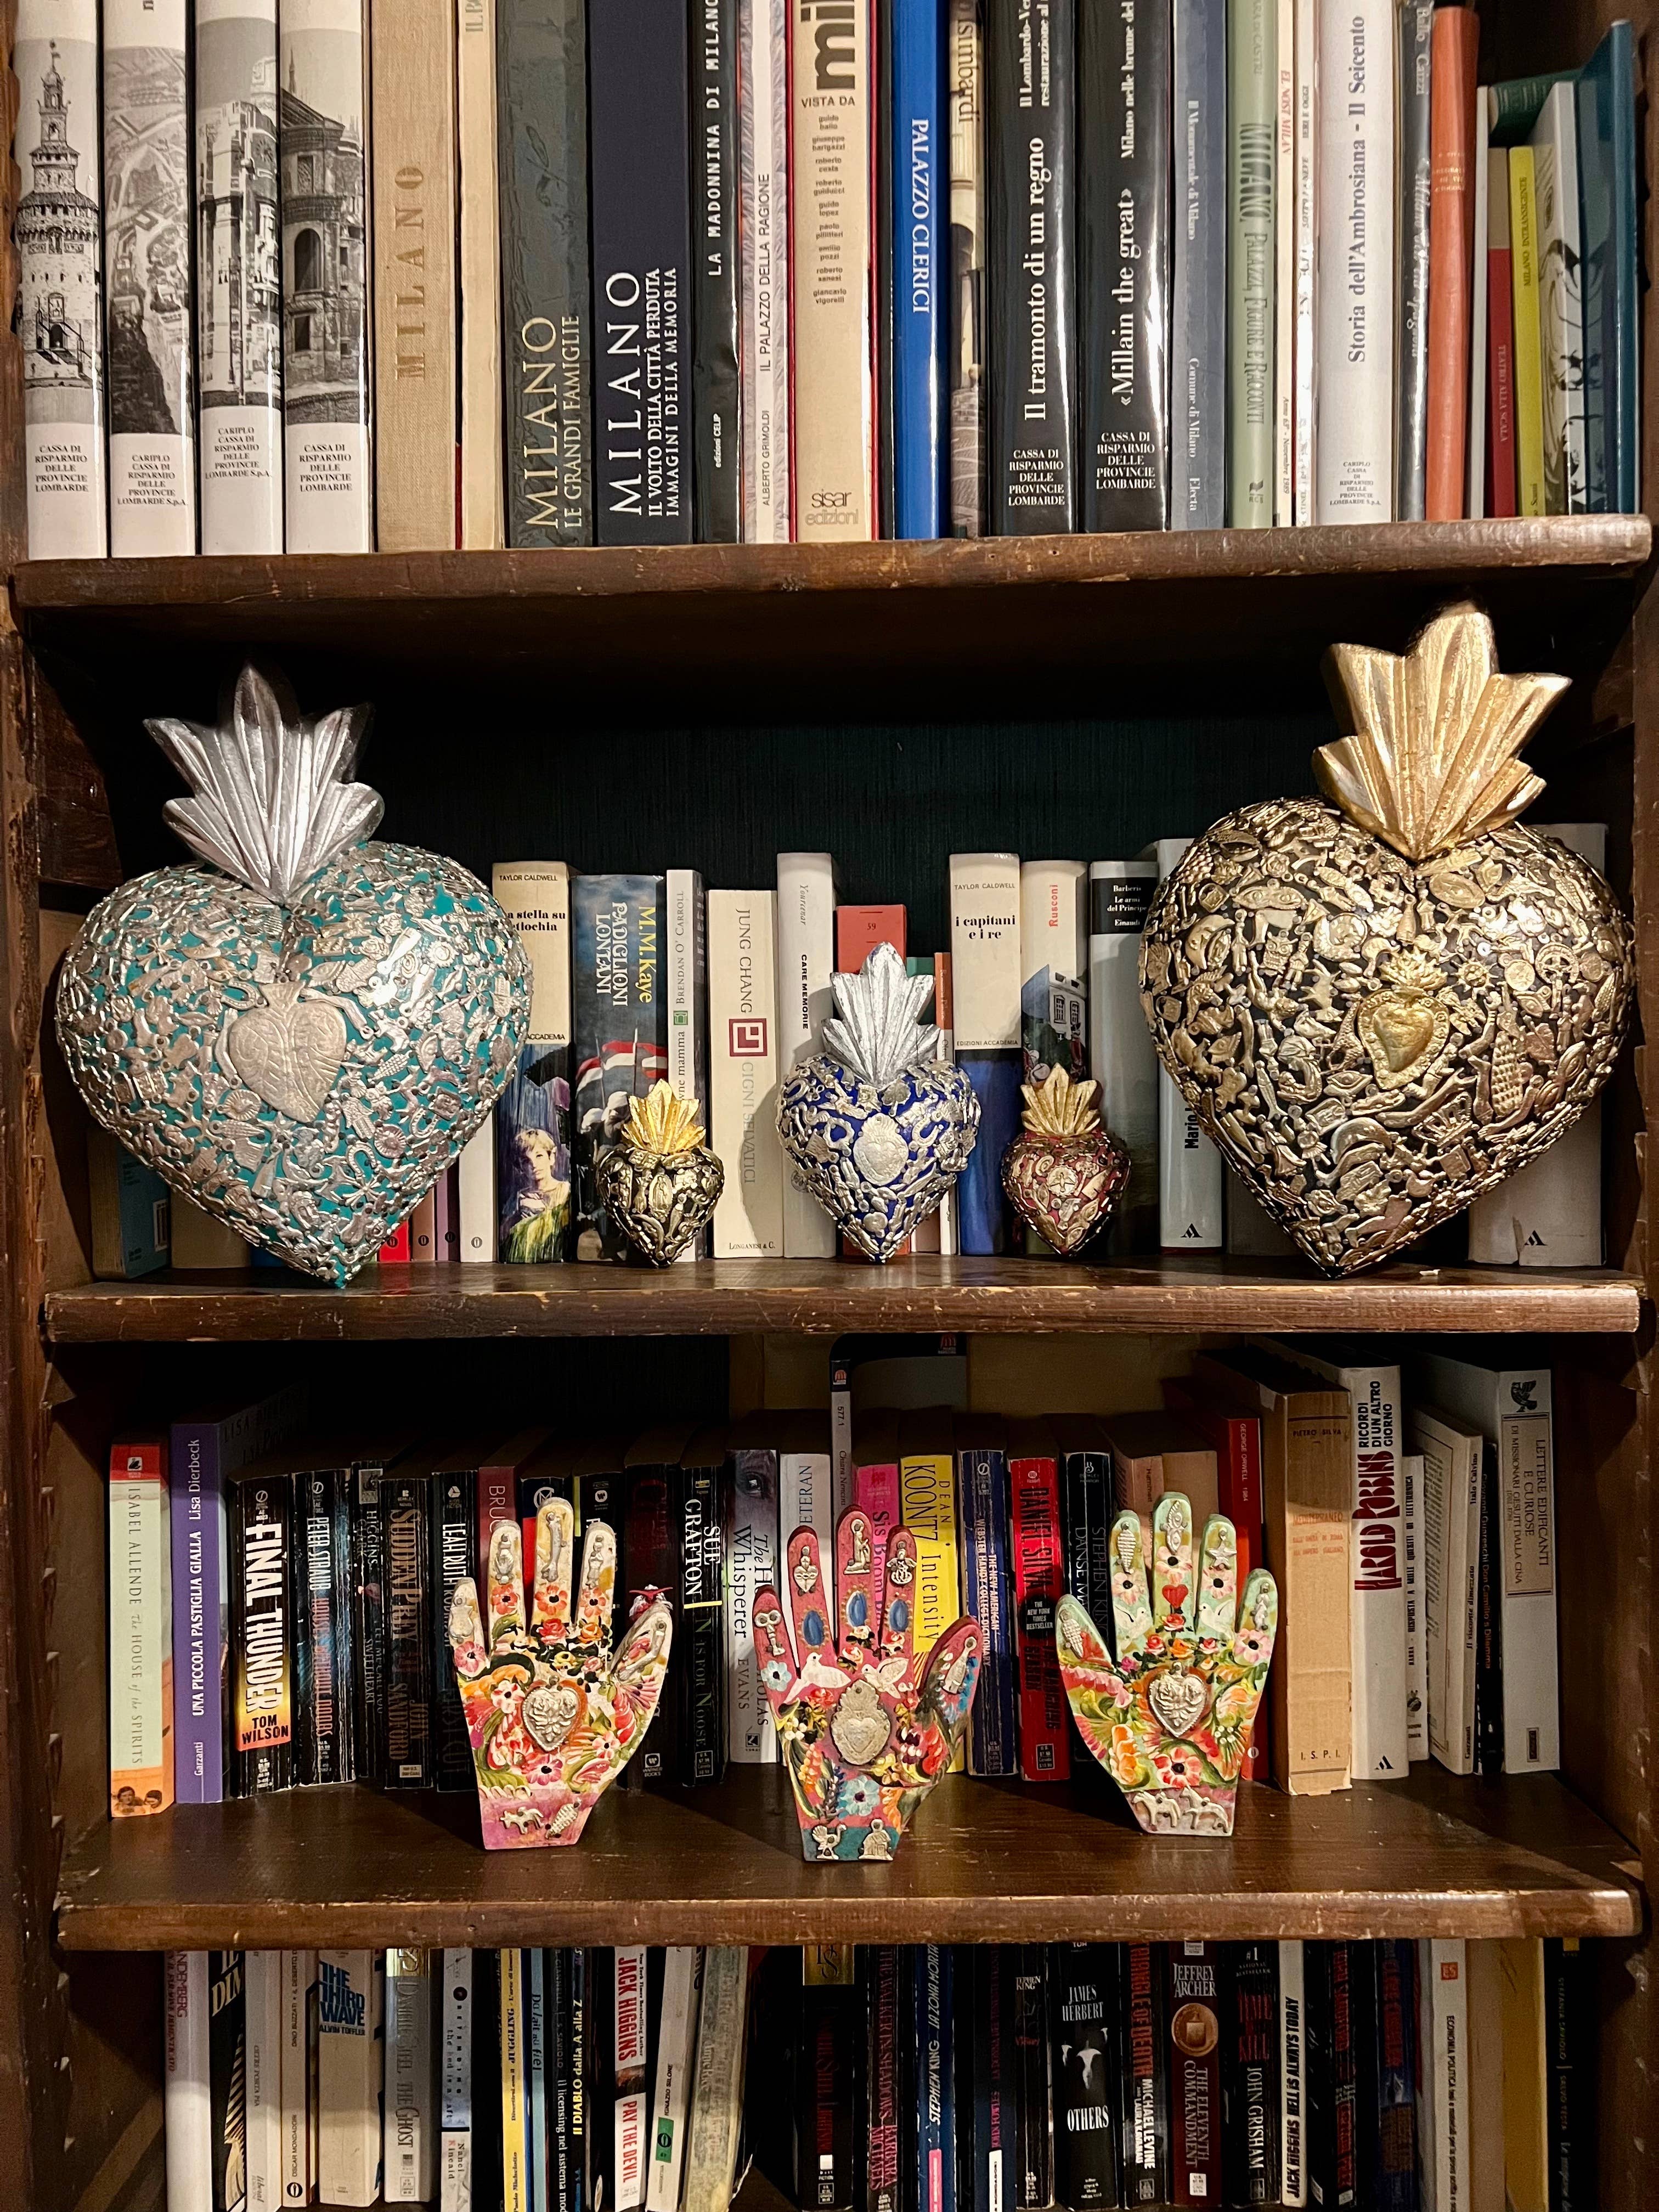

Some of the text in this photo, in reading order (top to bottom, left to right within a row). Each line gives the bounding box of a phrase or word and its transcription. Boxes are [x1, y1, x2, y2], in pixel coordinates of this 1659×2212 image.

[1348, 16, 1365, 93] Seicento
[706, 86, 720, 109] DI
[802, 96, 855, 108] VISTA DA
[1348, 104, 1365, 117] Il
[707, 125, 721, 237] MADONNINA
[912, 119, 929, 313] PALAZZO CLERICI
[395, 167, 425, 380] MILANO
[708, 252, 721, 275] LA
[1023, 137, 1052, 420] Il tramonto di un regno
[1111, 188, 1142, 406] «Millain the great»
[1348, 306, 1365, 362] Storia
[606, 272, 642, 516] MILANO
[644, 268, 662, 516] IL VOLTO DELLA CITTÀ PERDUTA
[664, 268, 679, 516] IMMAGINI DELLA MEMORIA
[522, 317, 558, 527] MILANO
[561, 315, 582, 527] LE GRANDI FAMIGLIE
[761, 410, 770, 458] GRIMOLDI
[1101, 431, 1150, 442] CASSA DI
[299, 454, 351, 462] RISPARMIO
[1009, 461, 1064, 471] RISPARMIO
[1014, 449, 1059, 459] CASSA DI
[1097, 443, 1155, 455] RISPARMIO
[1108, 455, 1144, 466] DELLE
[300, 474, 351, 482] PROVINCIE
[300, 483, 352, 492] LOMBARDE
[1009, 484, 1064, 494] PROVINCIE
[1019, 472, 1053, 482] DELLE
[1096, 479, 1156, 489] LOMBARDE
[1097, 467, 1155, 478] PROVINCIE
[805, 509, 858, 526] edizioni
[812, 489, 851, 508] sisar
[1008, 495, 1065, 506] LOMBARDE
[517, 910, 549, 918] stella
[956, 915, 1015, 928] i capitani
[1049, 884, 1058, 927] Rusconi
[596, 913, 611, 994] LONTANI
[612, 901, 629, 1007] PADIGLIONI
[969, 929, 1001, 940] e i re
[736, 909, 752, 1013] JUNG CHANG
[742, 1062, 755, 1183] CIGNI SELVATICI
[1184, 1113, 1199, 1149] Mario
[1358, 1402, 1369, 1449] RICORDI
[1370, 1380, 1381, 1447] DI UN ALTRO
[1383, 1403, 1393, 1447] GIORNO
[128, 1488, 140, 1534] ISABEL
[939, 1481, 951, 1523] DEAN
[1352, 1451, 1402, 1590] HAROLD ROBBINS
[1524, 1482, 1534, 1537] CURIOSE
[1536, 1440, 1548, 1566] LETTERE EDIFICANTI
[307, 1517, 330, 1552] PETER
[442, 1523, 466, 1555] LEAH
[685, 1499, 702, 1595] GRAFTON
[703, 1526, 720, 1565] SUE
[754, 1534, 769, 1563] The
[129, 1542, 142, 1604] ALLENDE
[188, 1439, 204, 1716] UNA PICCOLA PASTIGLIA GIALLA Lisa Dierbeck
[246, 1523, 283, 1606] FINAL
[309, 1550, 331, 1590] STRAUB
[443, 1555, 466, 1585] RUTH
[723, 1524, 752, 1638] Whisperer
[918, 1555, 944, 1639] Intensity
[132, 1615, 140, 1629] The
[1026, 1622, 1053, 1630] BESTSELLER
[132, 1635, 142, 1678] HOUSE
[246, 1607, 283, 1713] THUNDER
[738, 1658, 749, 1709] EVANS
[132, 1716, 142, 1764] SPIRITS
[242, 1725, 289, 1744] WILSON
[252, 1714, 277, 1728] TOM
[194, 1742, 203, 1776] Garzanti
[1172, 1963, 1215, 1981] JEFFREY
[1246, 1947, 1259, 1961] #1
[319, 1961, 350, 1989] THE
[1069, 1984, 1097, 2004] JAMES
[1174, 1979, 1217, 1997] ARCHER
[319, 1982, 365, 2009] THIRD
[319, 2001, 365, 2027] WAVE
[618, 1957, 637, 2061] JACK HIGGINS
[1062, 2002, 1104, 2022] HERBERT
[573, 2011, 582, 2032] alla
[573, 2035, 582, 2044] A
[573, 2047, 582, 2075] dalla
[573, 2079, 582, 2124] DIABLO
[928, 2040, 940, 2124] STEPHEN KING
[556, 2089, 567, 2133] licensing
[1067, 2104, 1109, 2132] OTHERS
[1184, 2060, 1197, 2168] COMMANDMENT
[1196, 2067, 1209, 2162] THE ELEVENTH
[1247, 2067, 1263, 2169] JOHN GRISHAM
[558, 2135, 567, 2151] nel
[623, 2101, 637, 2183] PAY THE DEVIL
